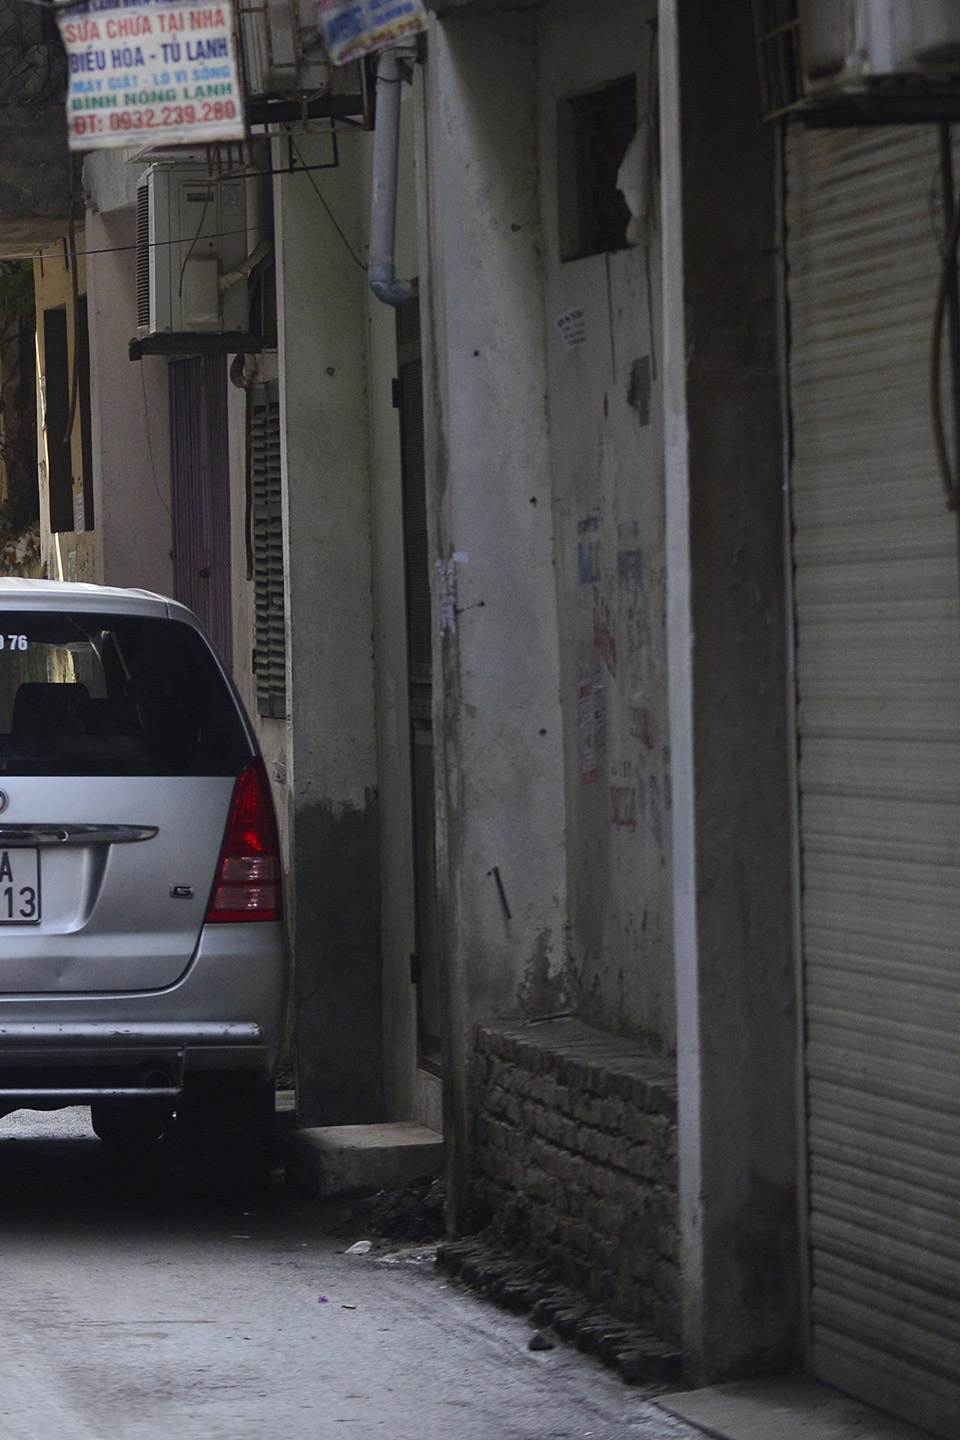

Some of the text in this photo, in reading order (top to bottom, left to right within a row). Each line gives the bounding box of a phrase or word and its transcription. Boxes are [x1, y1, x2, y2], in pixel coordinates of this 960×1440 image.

[186, 37, 229, 67] LẠNH
[183, 82, 233, 104] LẠNH
[109, 100, 237, 132] 0932.239.280
[8, 635, 28, 650] 76
